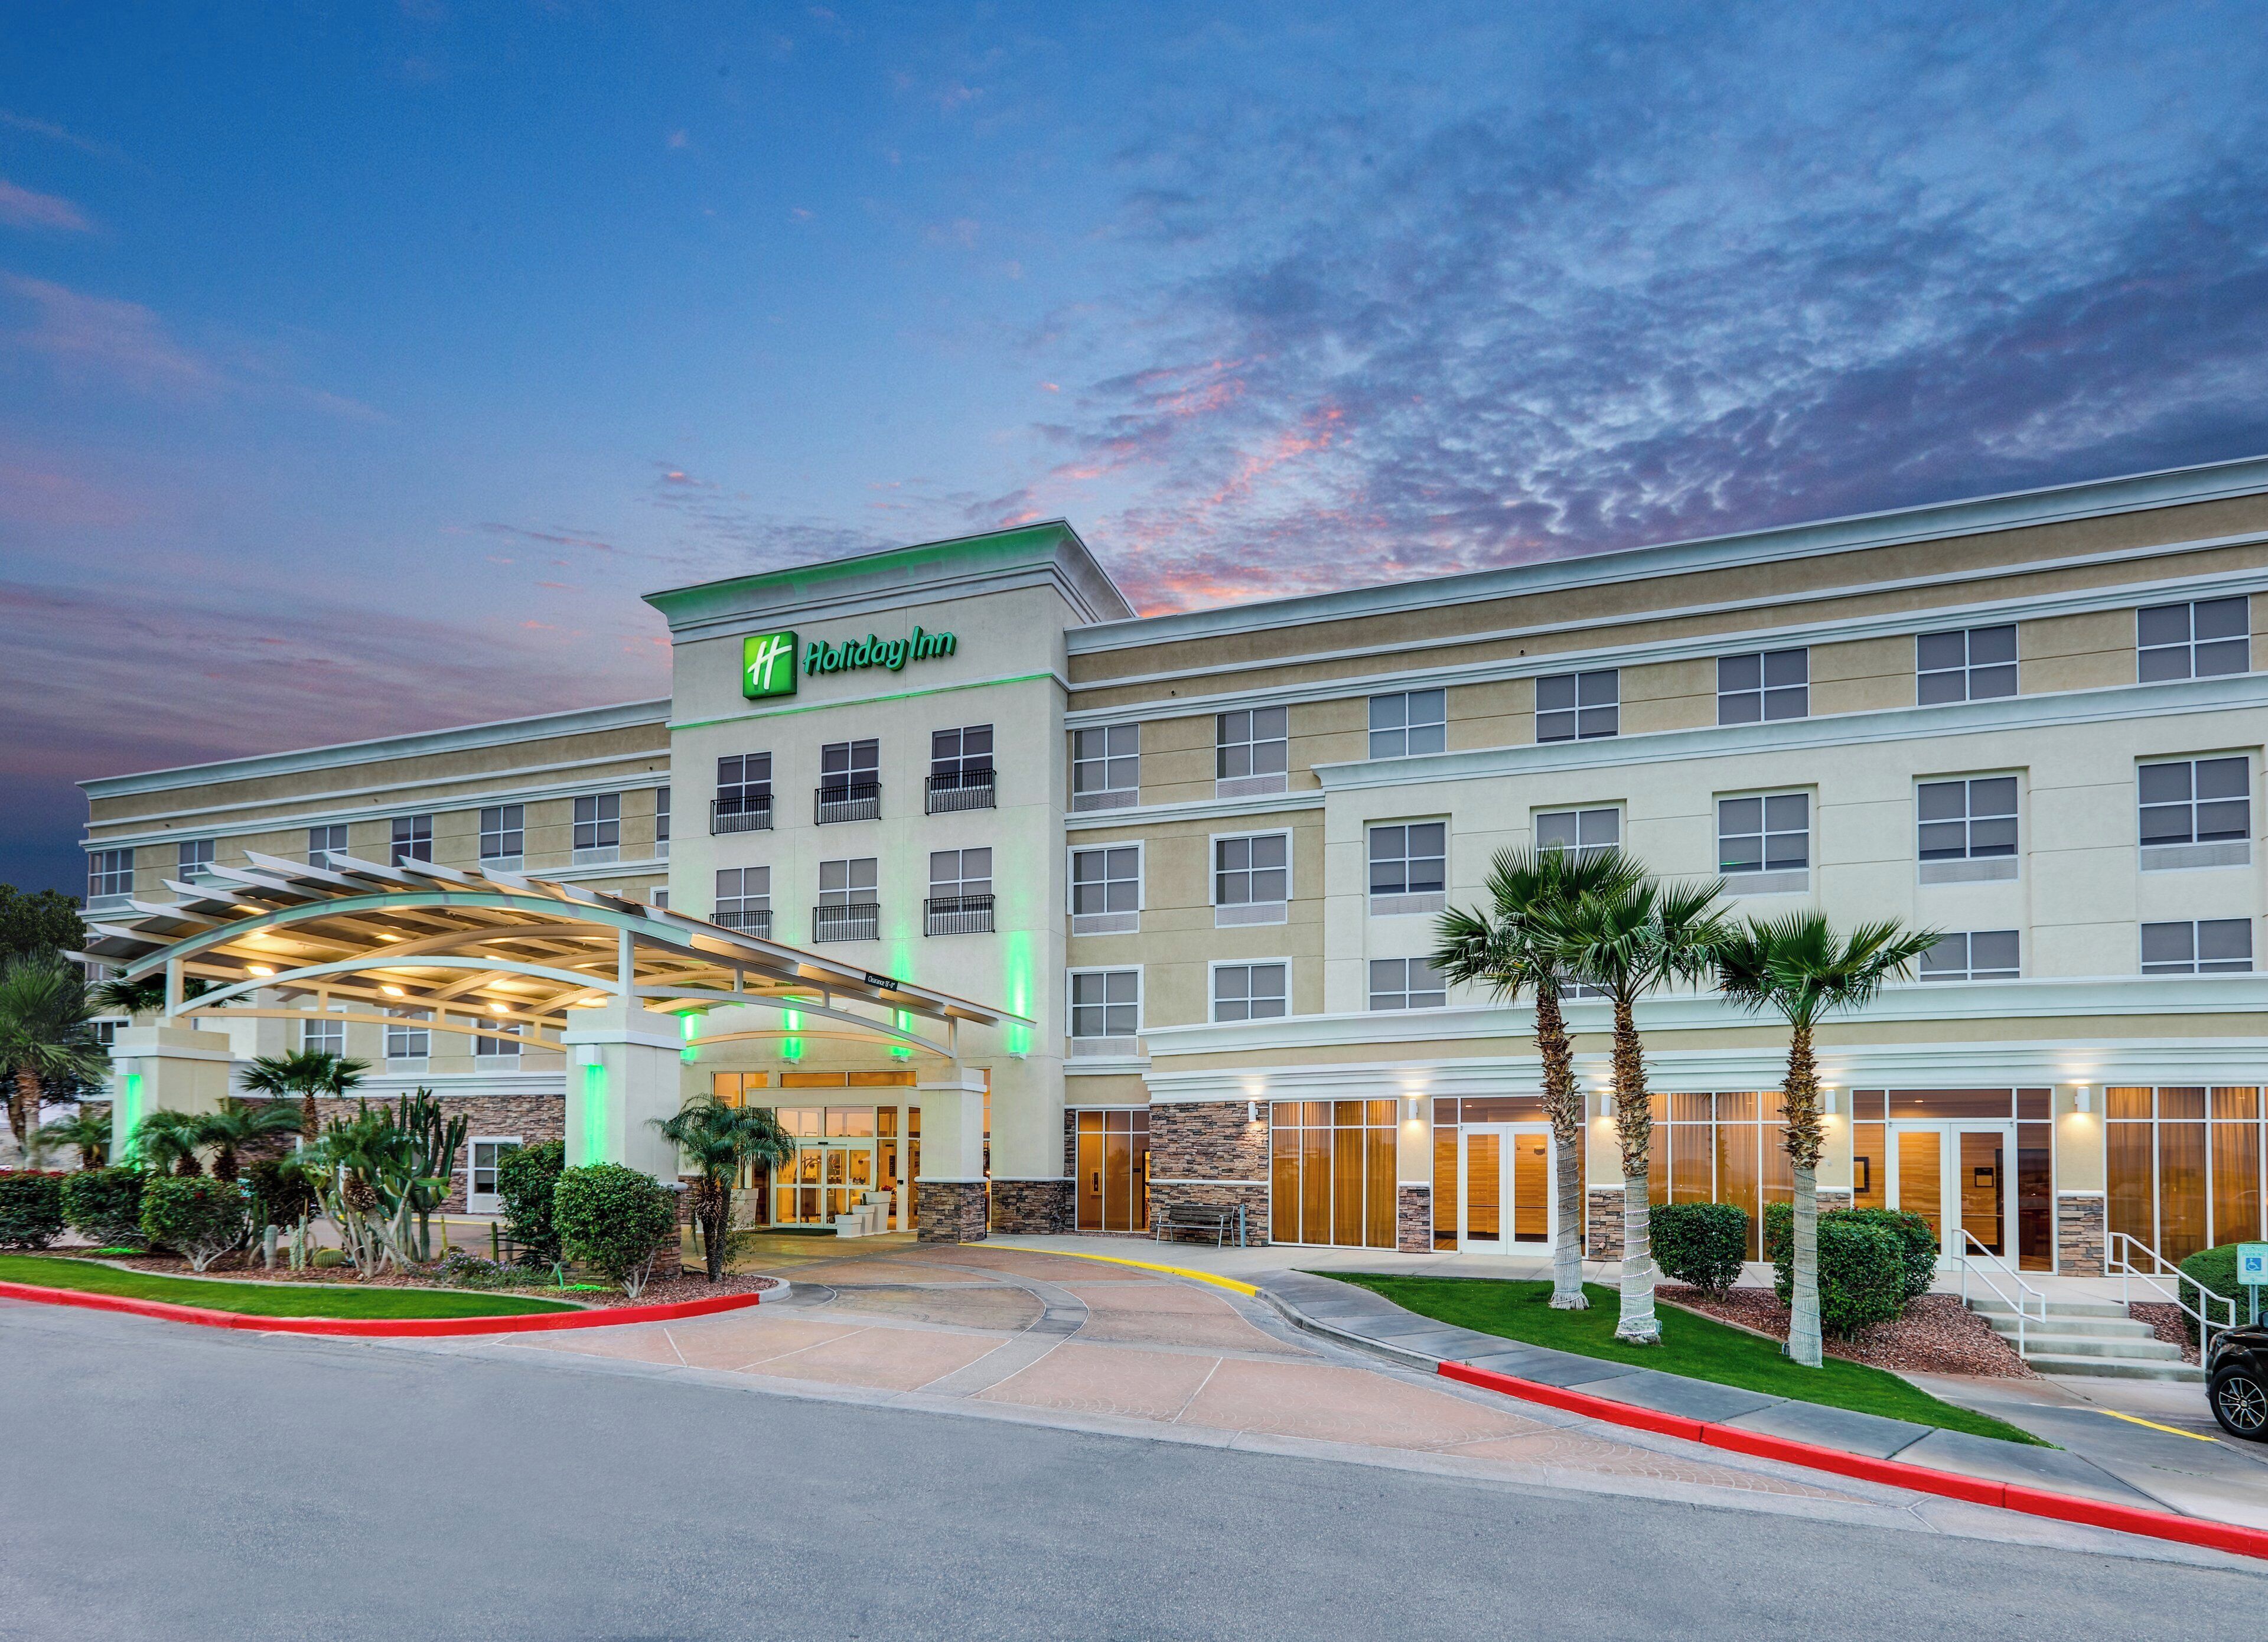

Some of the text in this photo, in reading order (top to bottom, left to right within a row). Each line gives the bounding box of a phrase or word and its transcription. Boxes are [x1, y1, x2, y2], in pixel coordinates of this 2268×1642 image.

[803, 625, 956, 676] Holiday Inn
[868, 975, 885, 986] Clearance
